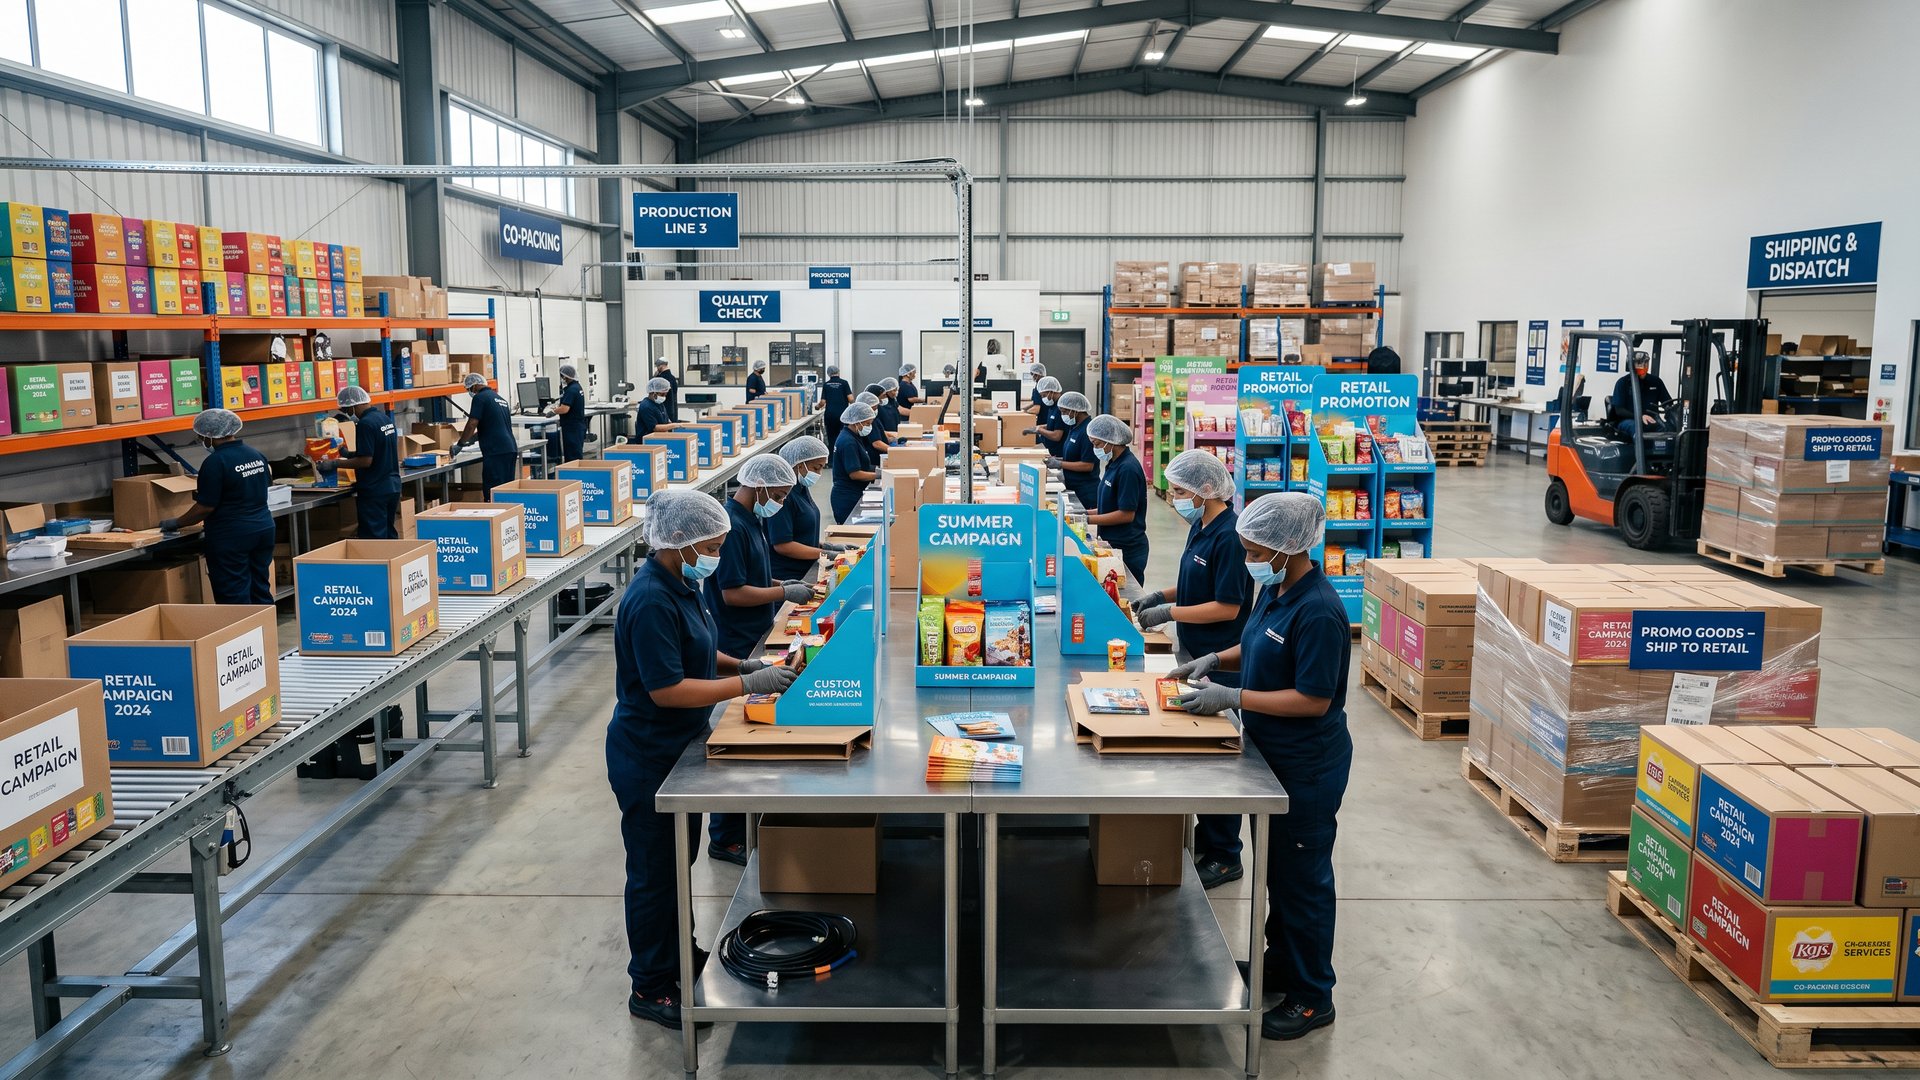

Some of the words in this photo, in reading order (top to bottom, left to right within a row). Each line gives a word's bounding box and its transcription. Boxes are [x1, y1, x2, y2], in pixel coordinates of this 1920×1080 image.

[639, 206, 732, 219] PRODUCTION
[665, 222, 695, 235] LINE
[698, 222, 708, 235] 3
[503, 223, 561, 253] CO-PACKING
[1764, 233, 1842, 259] SHIPPING
[1845, 232, 1858, 252] &
[1769, 257, 1850, 282] DISPATCH
[711, 294, 769, 307] QUALITY
[717, 308, 763, 320] CHECK
[1260, 371, 1302, 382] RETAIL
[1340, 381, 1391, 394] RETAIL
[1320, 395, 1410, 409] PROMOTION
[1842, 435, 1872, 443] GOODS
[1845, 444, 1875, 452] RETAIL
[937, 515, 1014, 529] SUMMER
[438, 537, 469, 545] RETAIL
[929, 532, 1023, 547] CAMPAIGN
[437, 546, 479, 554] AMPAIGN
[443, 555, 465, 563] 2024
[324, 585, 362, 595] RETAIL
[313, 595, 374, 606] CAMPAIGN
[330, 607, 358, 617] 2024
[1602, 621, 1632, 630] RETAI
[1640, 627, 1693, 638] PROMO
[1695, 627, 1745, 639] GOODS
[1604, 640, 1628, 648] 2024
[1645, 641, 1679, 654] SHIP
[1681, 642, 1700, 653] TO
[1702, 642, 1750, 654] RETAIL
[227, 645, 254, 668] RETAIL
[219, 655, 263, 687] CAMPAIGN
[934, 673, 970, 681] SUMMER
[971, 673, 1018, 681] CAMPAIGN
[105, 675, 157, 687] RETAIL
[814, 679, 861, 689] CUSTOM
[103, 689, 173, 702] AMPAIGN
[806, 689, 863, 699] CAMPAIGN
[114, 704, 152, 717] 2024
[14, 735, 63, 770] RETAIL
[1, 747, 78, 796] CAMPAIGN
[1718, 797, 1747, 826] RETAIL
[1709, 806, 1755, 845] CAMPAIGN
[1720, 826, 1741, 849] 2024
[1645, 834, 1669, 861] RETAIL
[1637, 842, 1676, 880] CAMPAIGN
[1711, 895, 1742, 929] RETAIL
[1702, 904, 1750, 951] CAMPAIGN
[1844, 948, 1891, 957] SERVICES
